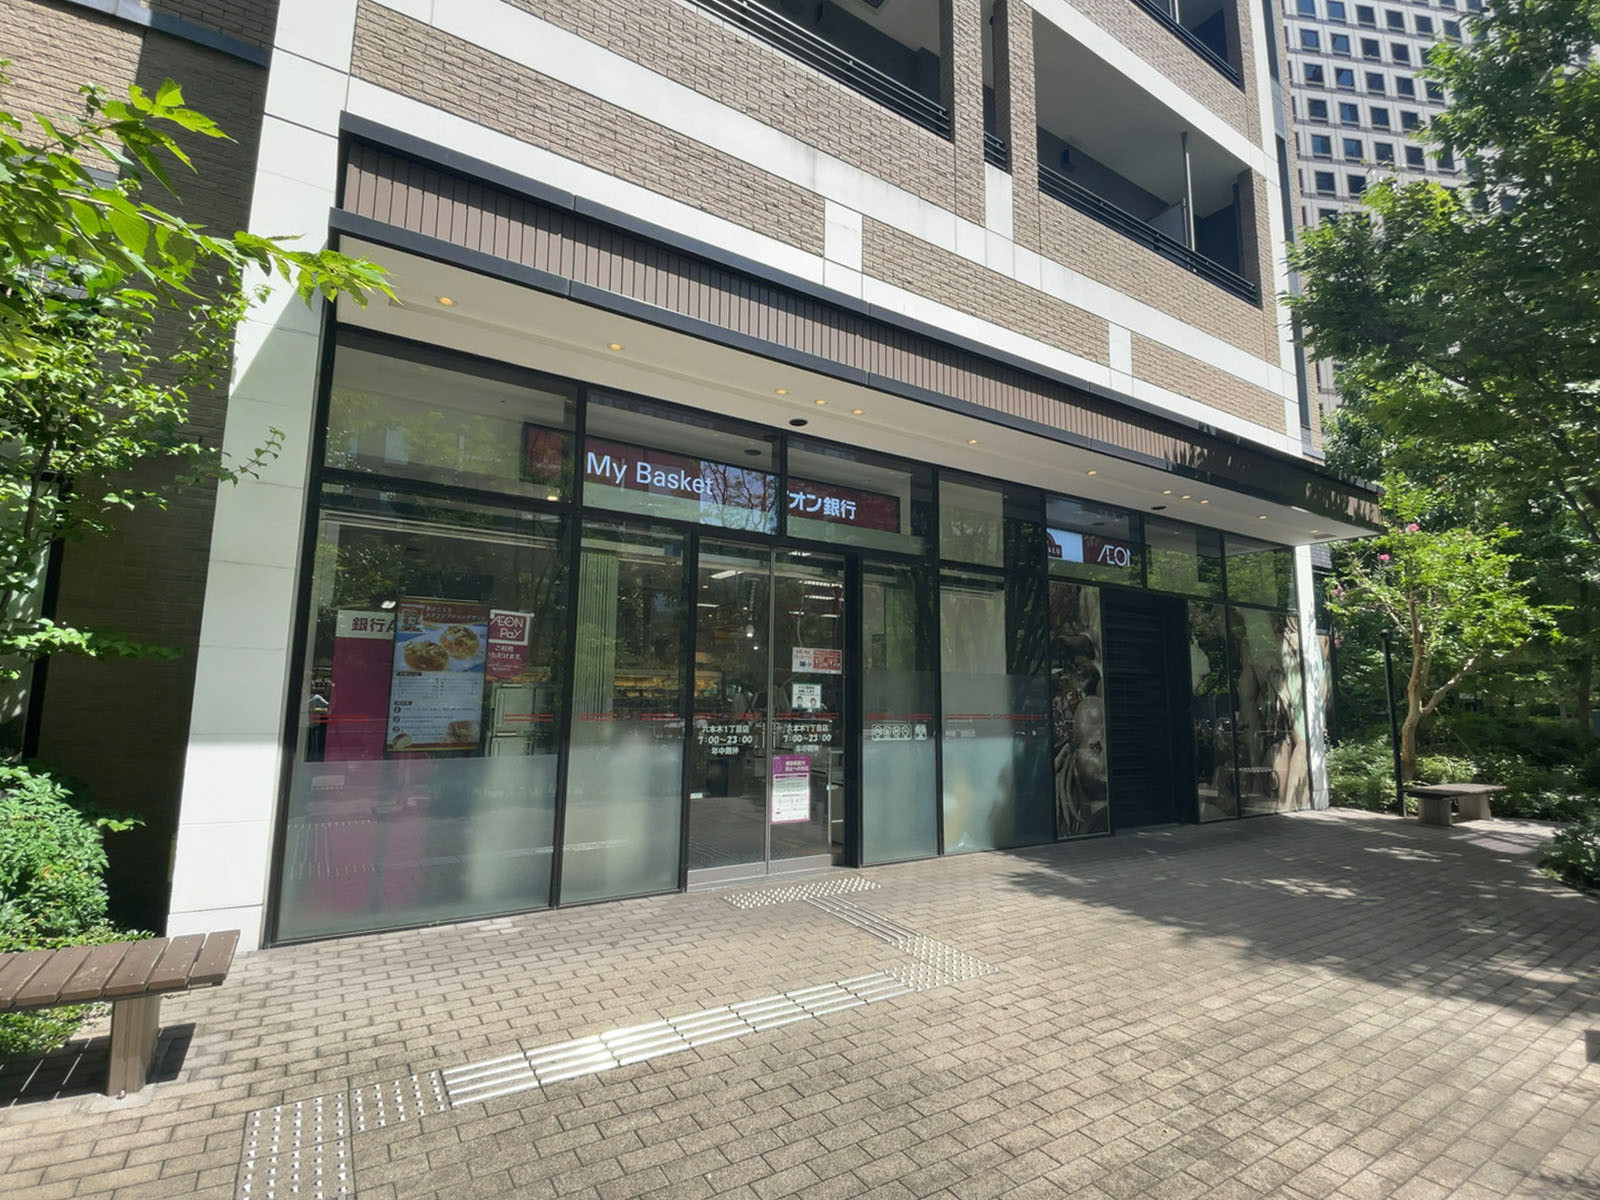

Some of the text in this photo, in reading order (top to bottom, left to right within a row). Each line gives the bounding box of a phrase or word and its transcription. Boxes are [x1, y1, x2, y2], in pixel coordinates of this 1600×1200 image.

[586, 450, 714, 497] My Basket
[786, 490, 857, 520] オン銀行
[500, 628, 523, 639] Pay
